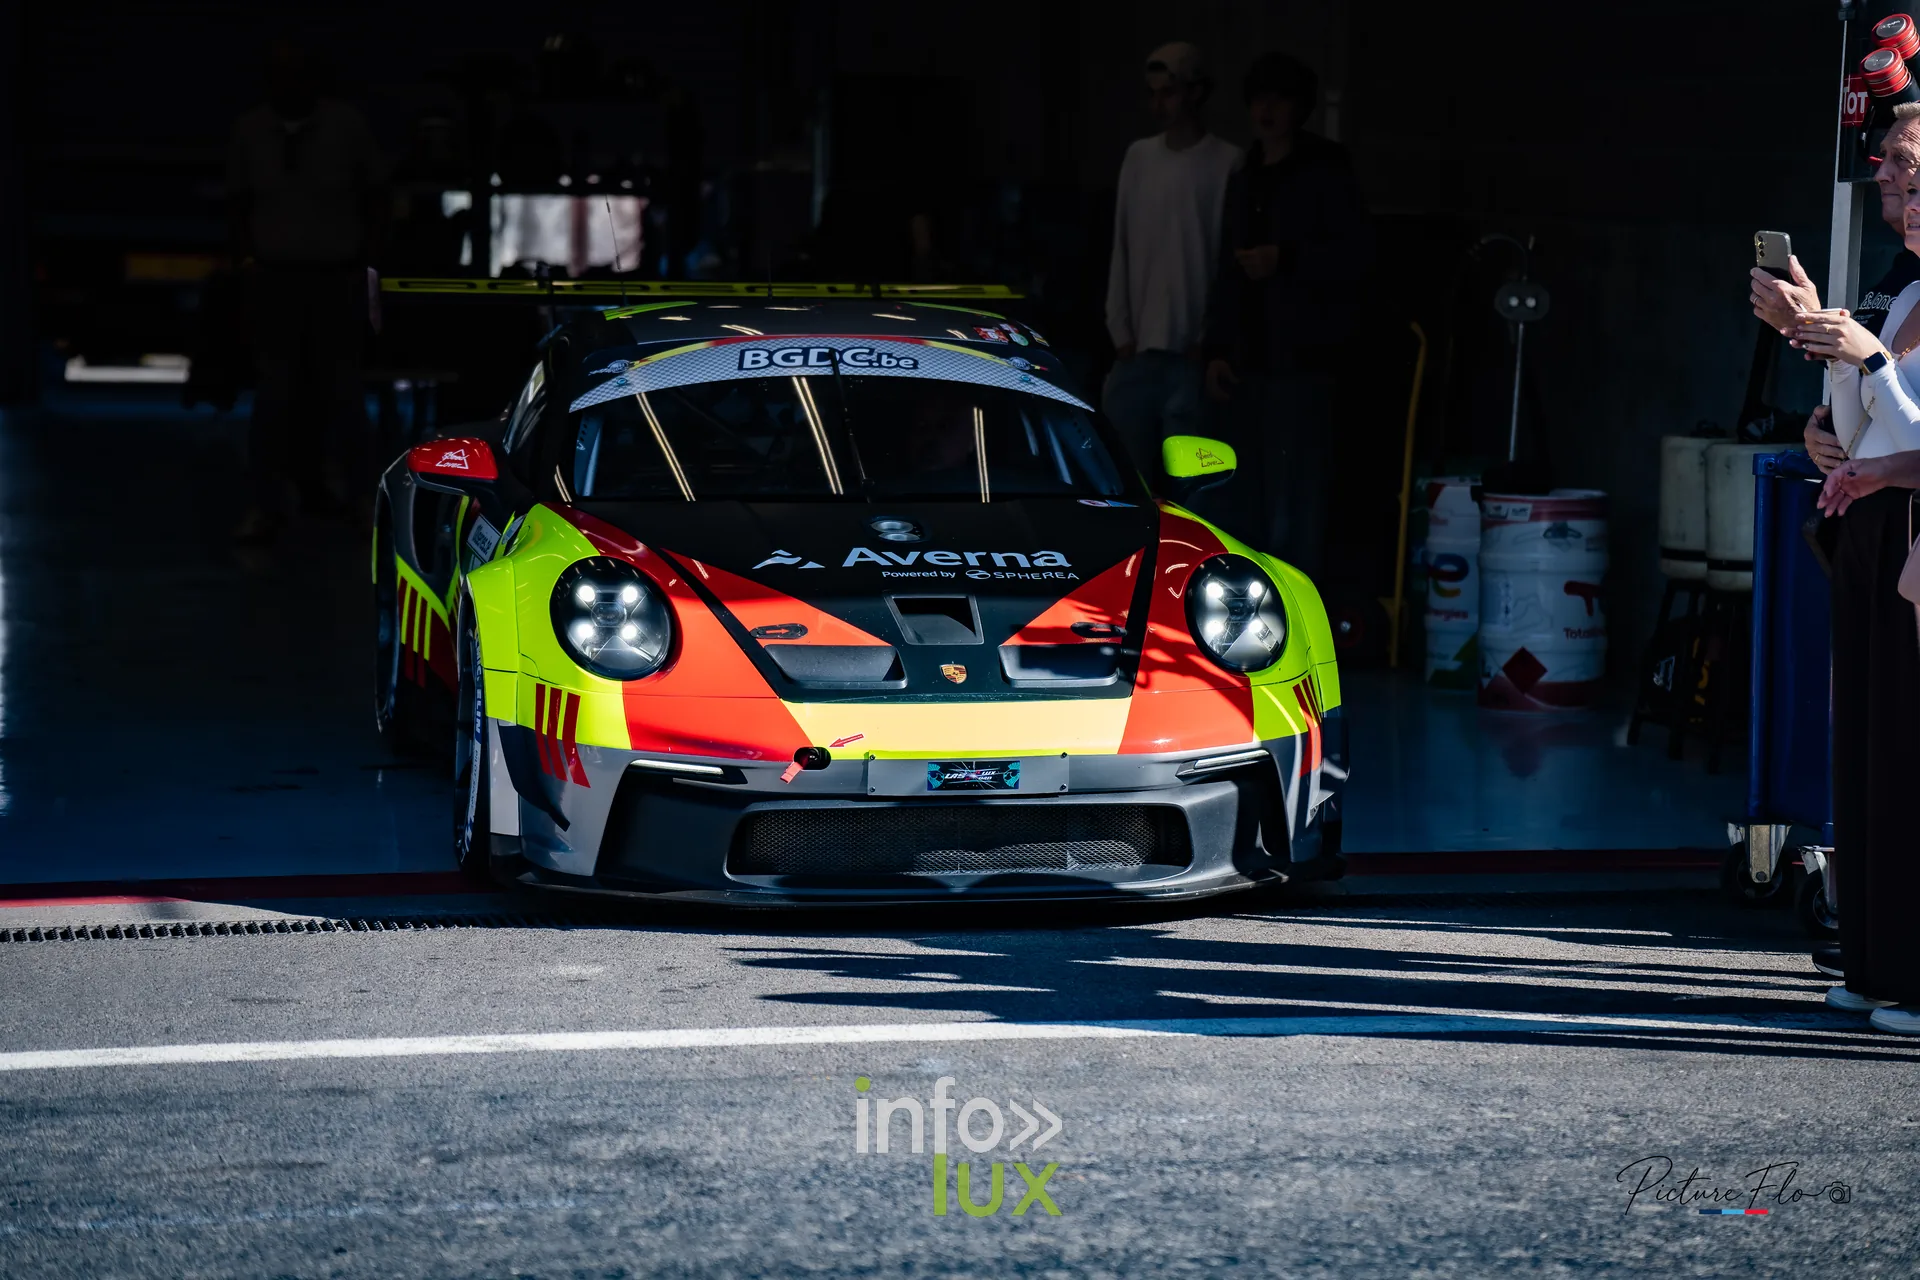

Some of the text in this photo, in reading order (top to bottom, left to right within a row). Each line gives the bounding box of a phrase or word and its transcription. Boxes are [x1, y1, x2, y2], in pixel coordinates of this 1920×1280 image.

[740, 347, 916, 370] BGDC.be
[842, 547, 1072, 568] Averna
[882, 569, 1080, 580] Powered by SPHEREA
